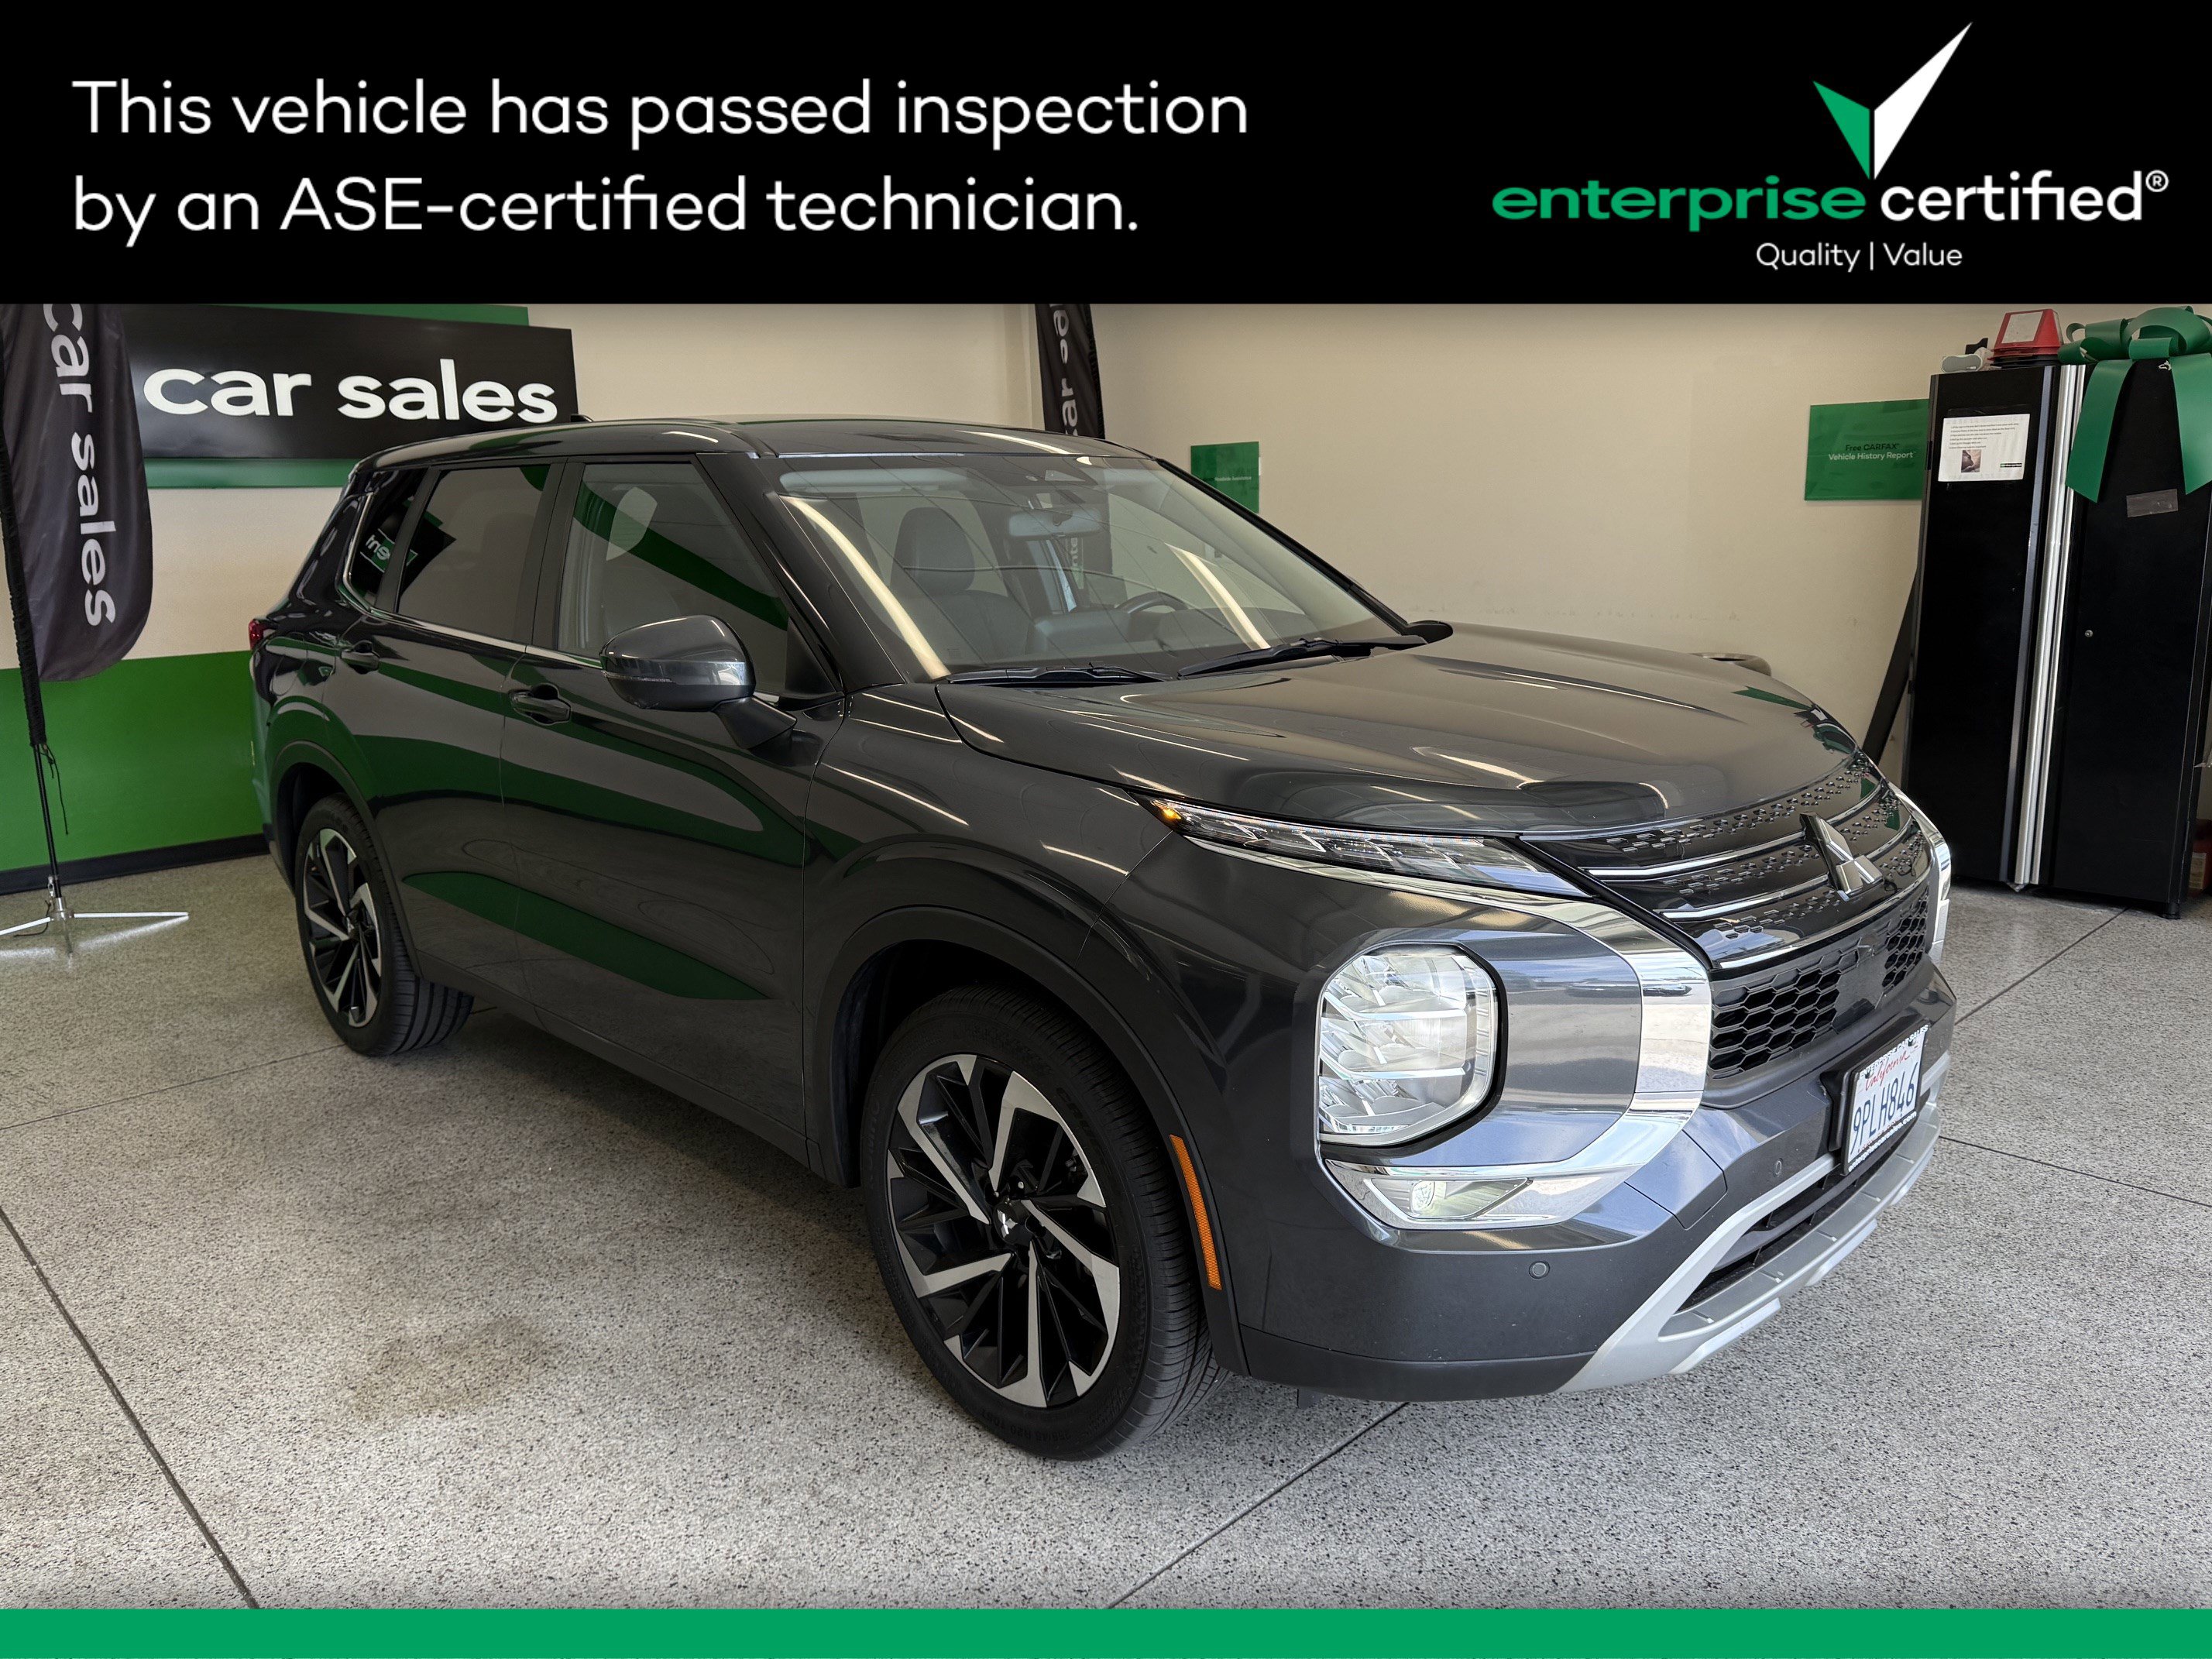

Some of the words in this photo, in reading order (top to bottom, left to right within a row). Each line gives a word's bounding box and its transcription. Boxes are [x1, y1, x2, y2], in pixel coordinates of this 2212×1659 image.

[143, 369, 312, 417] car
[337, 359, 558, 423] sales
[1856, 452, 1885, 461] History
[71, 432, 118, 627] sales
[1850, 1062, 1918, 1156] 9PLH846
